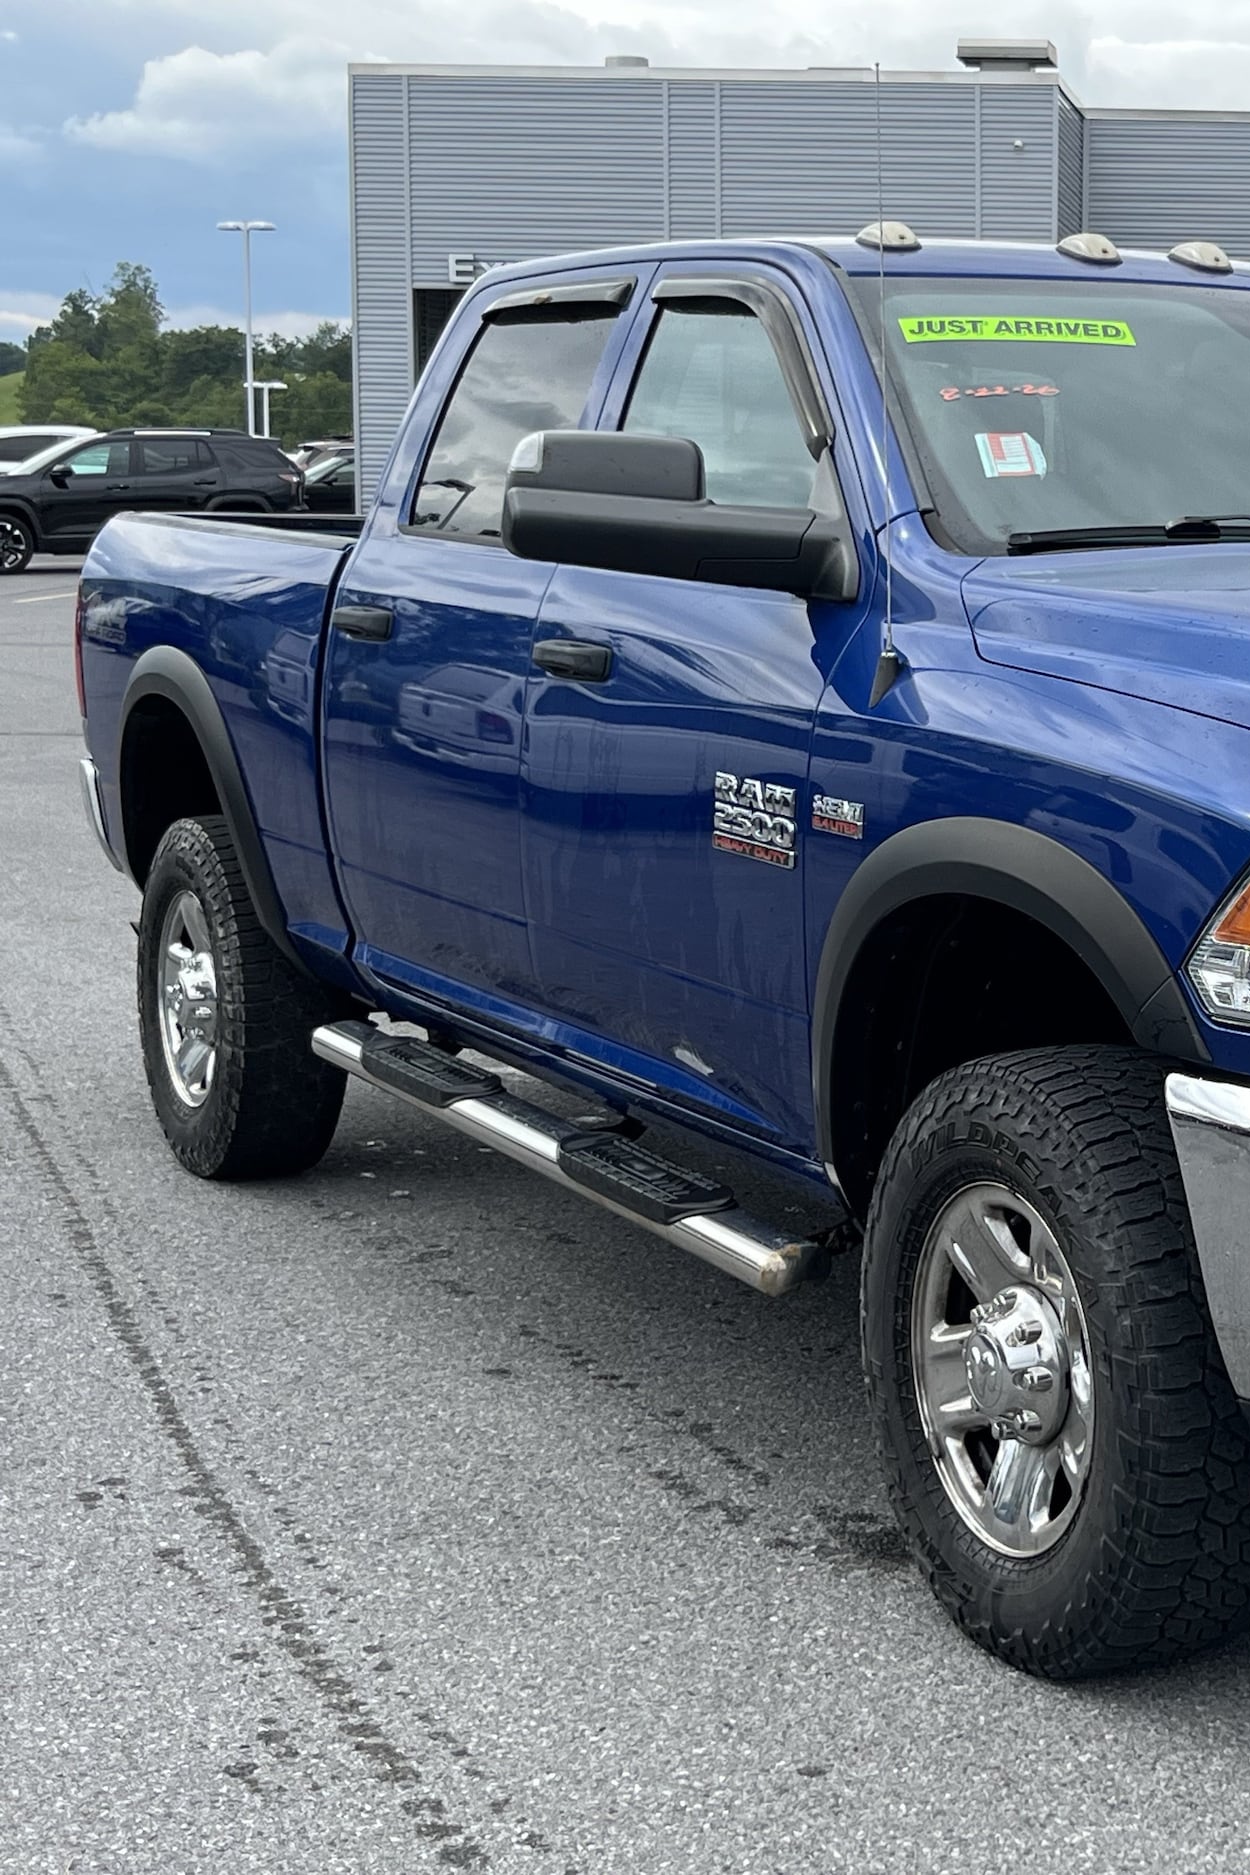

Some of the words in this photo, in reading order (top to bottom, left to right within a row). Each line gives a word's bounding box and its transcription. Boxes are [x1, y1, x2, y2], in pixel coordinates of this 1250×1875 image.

[909, 320, 985, 337] JUST
[993, 320, 1128, 339] ARRIVED
[715, 770, 797, 817] RAM
[714, 802, 797, 848] 2500
[754, 848, 789, 866] DUTY
[908, 1120, 1084, 1253] WILDPEAK
